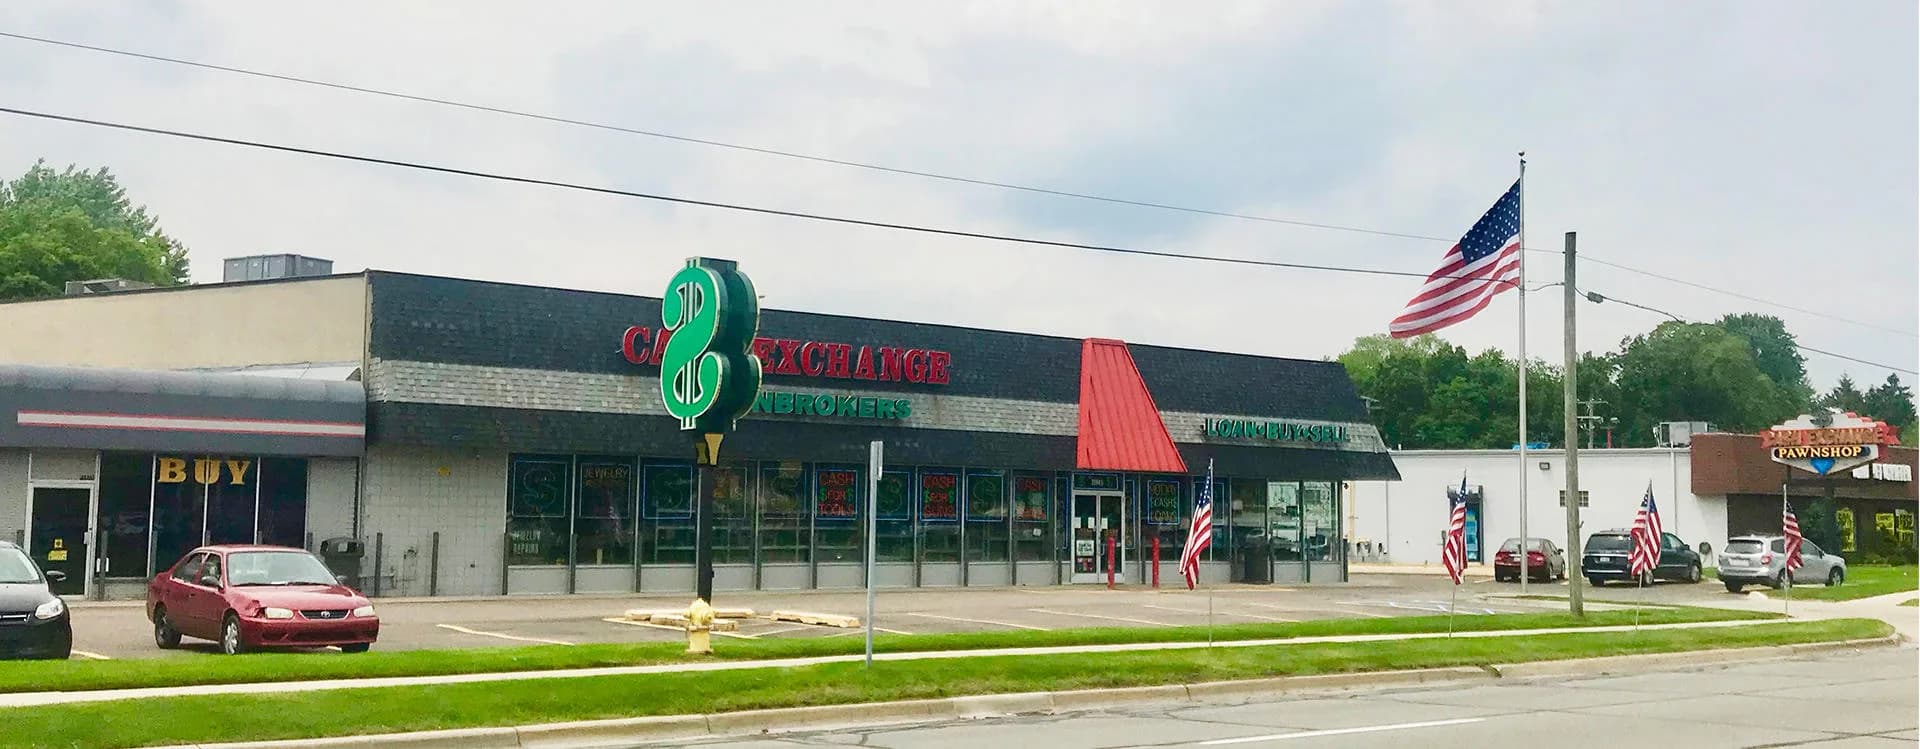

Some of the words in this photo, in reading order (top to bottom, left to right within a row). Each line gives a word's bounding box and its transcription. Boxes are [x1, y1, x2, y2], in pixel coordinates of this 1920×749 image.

[753, 336, 952, 386] EXCHANGE
[1778, 446, 1862, 459] PAWNSHOP
[157, 457, 250, 486] BUY
